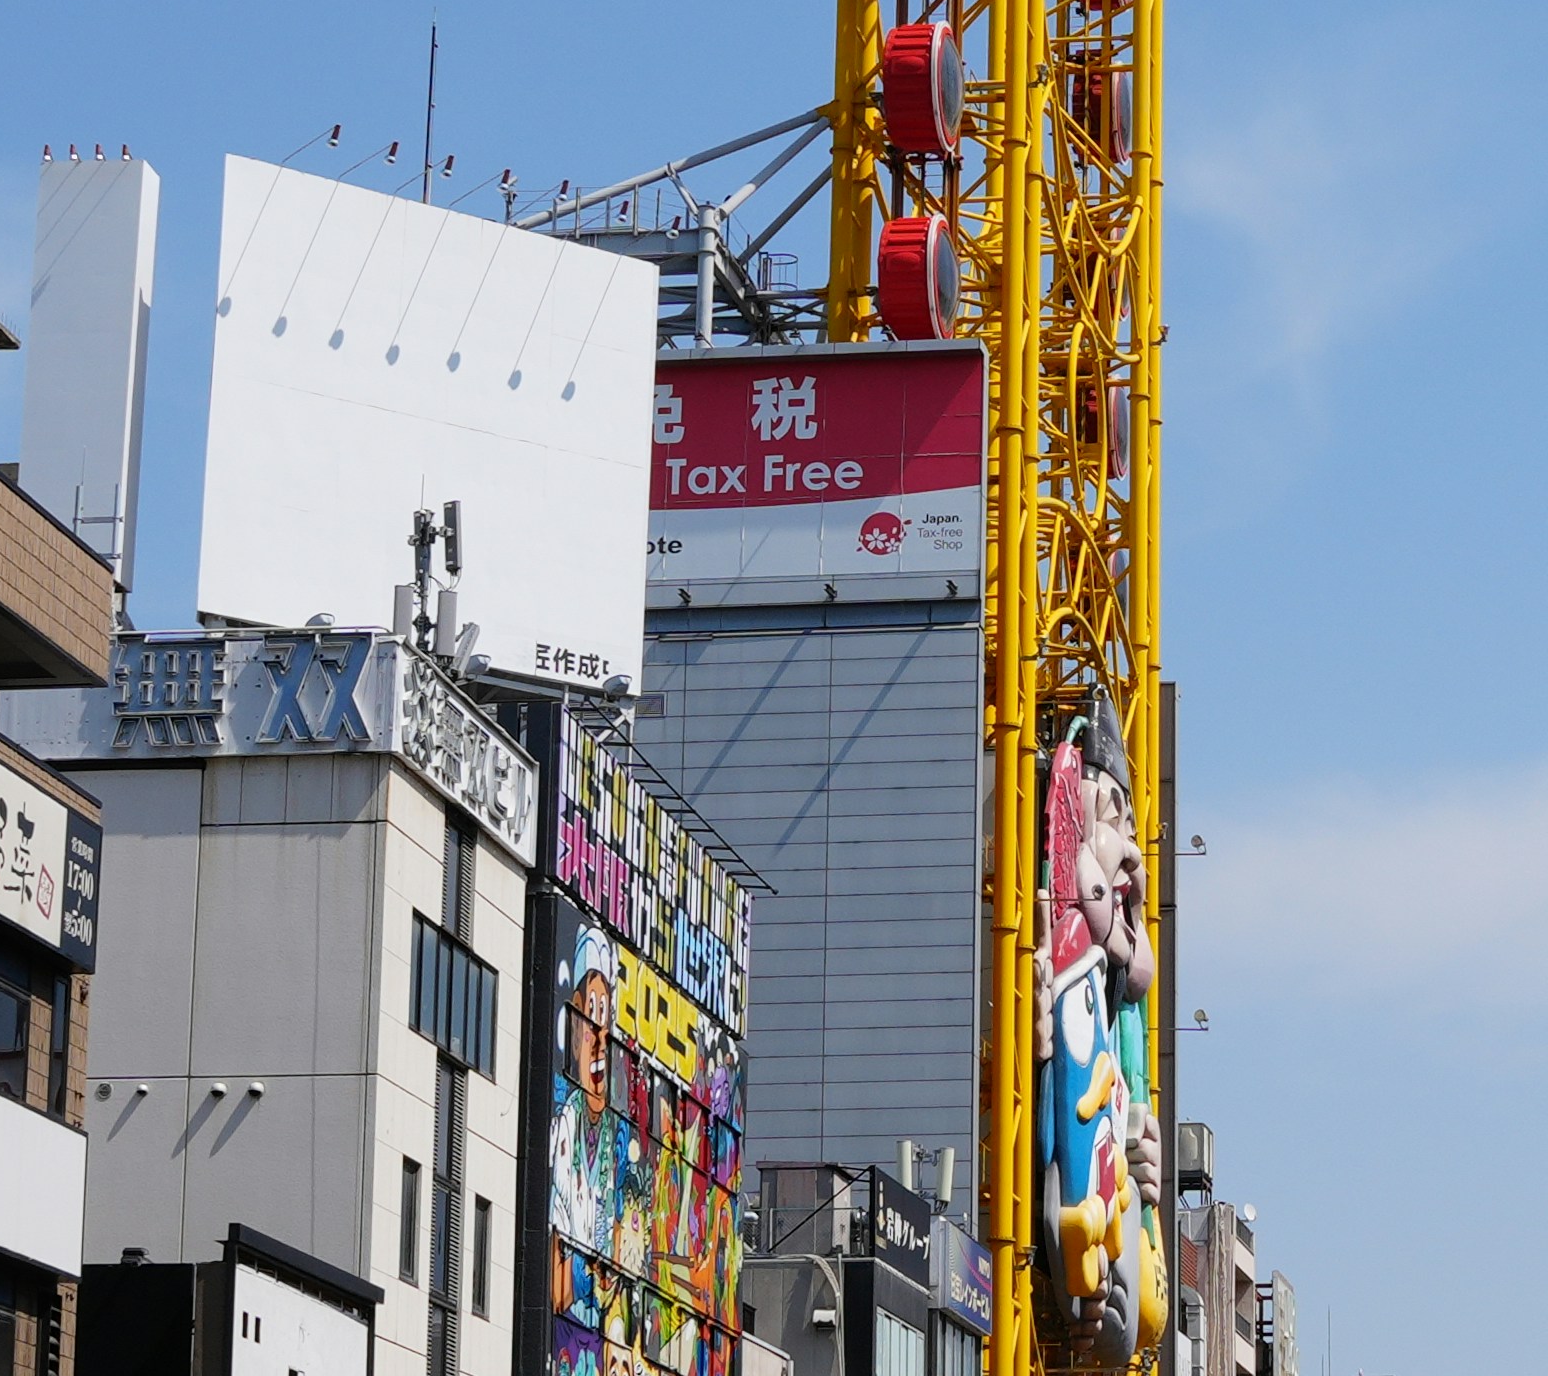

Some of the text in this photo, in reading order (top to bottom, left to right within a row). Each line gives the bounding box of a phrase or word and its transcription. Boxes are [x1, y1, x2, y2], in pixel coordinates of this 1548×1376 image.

[665, 453, 864, 496] Tax Free
[917, 526, 964, 540] Tax-free
[921, 512, 963, 527] Japan.
[933, 538, 964, 552] Shop
[67, 859, 94, 902] 17:00
[886, 1207, 931, 1260] グループ
